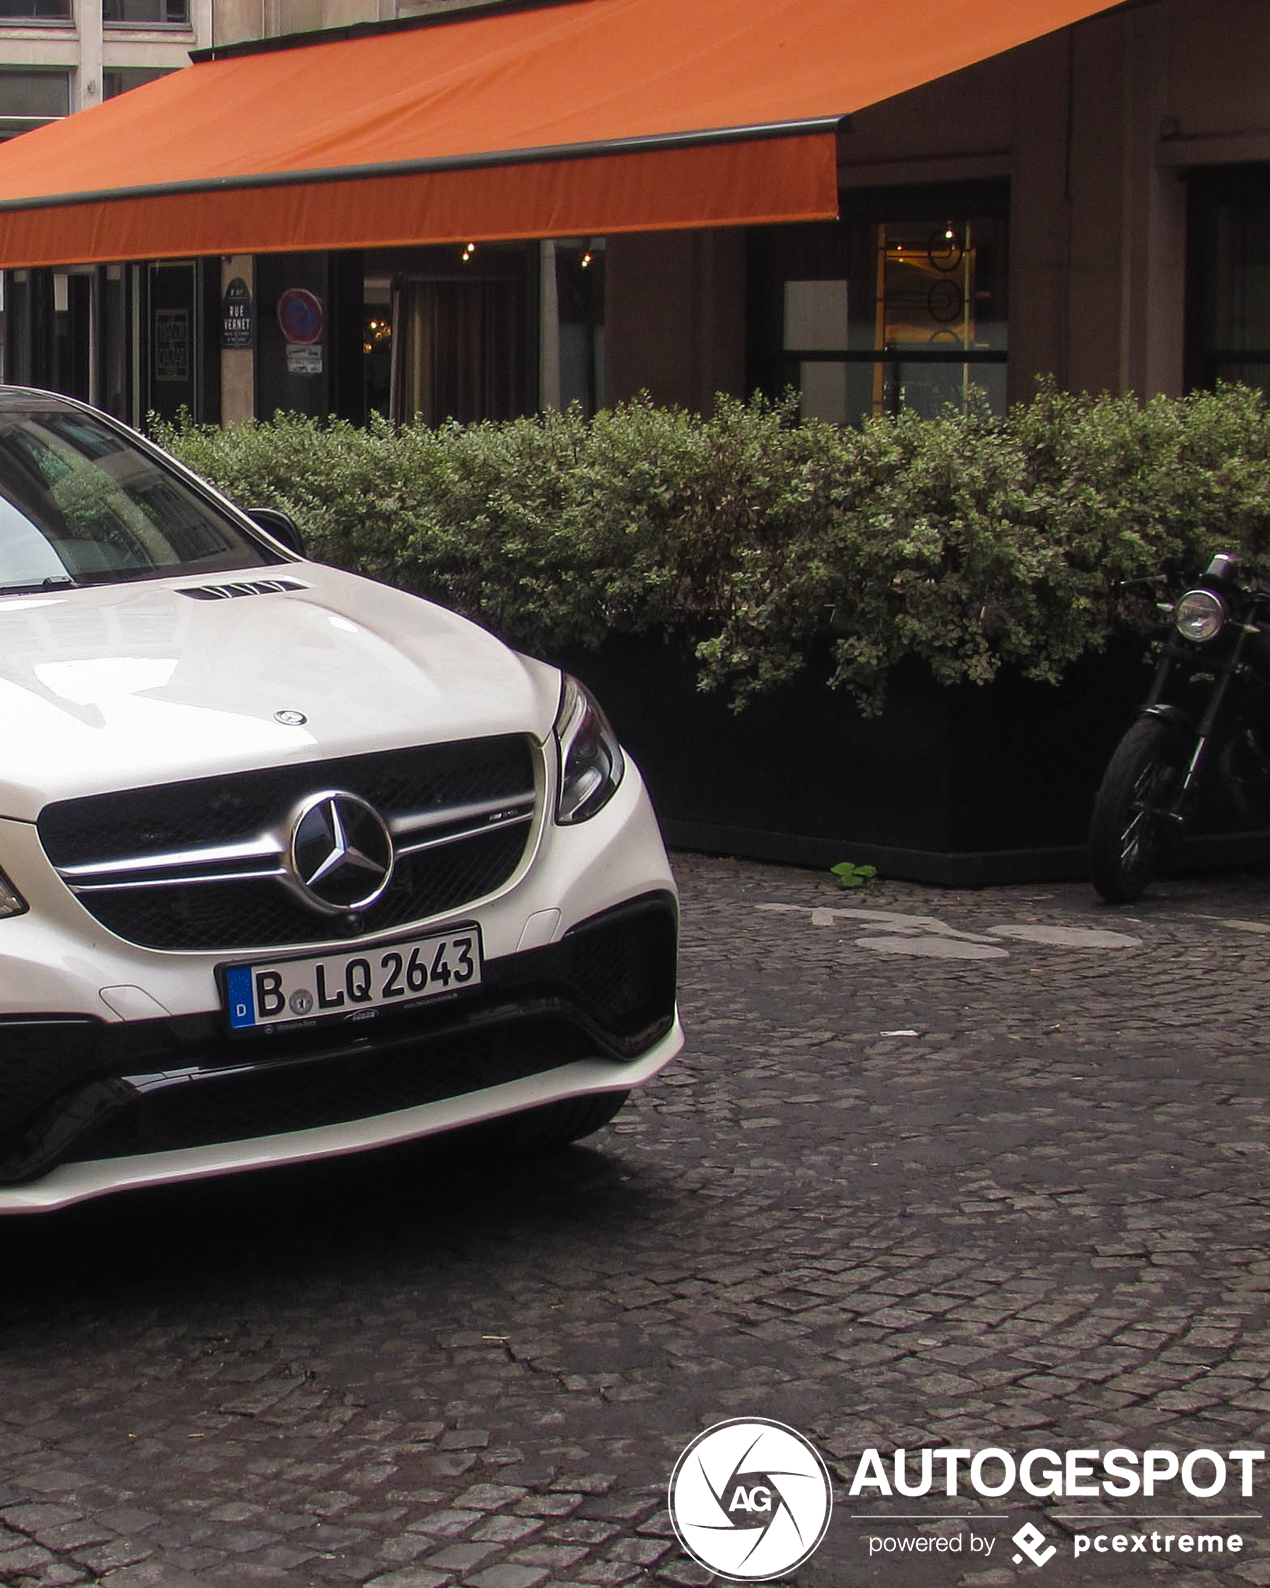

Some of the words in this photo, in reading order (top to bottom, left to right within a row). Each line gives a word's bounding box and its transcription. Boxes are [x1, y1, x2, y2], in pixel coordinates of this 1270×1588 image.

[229, 305, 244, 317] RUE
[224, 319, 250, 330] VERNET
[255, 971, 285, 1018] B
[316, 958, 373, 1008] LQ
[381, 937, 474, 998] 2643
[236, 1004, 246, 1017] D
